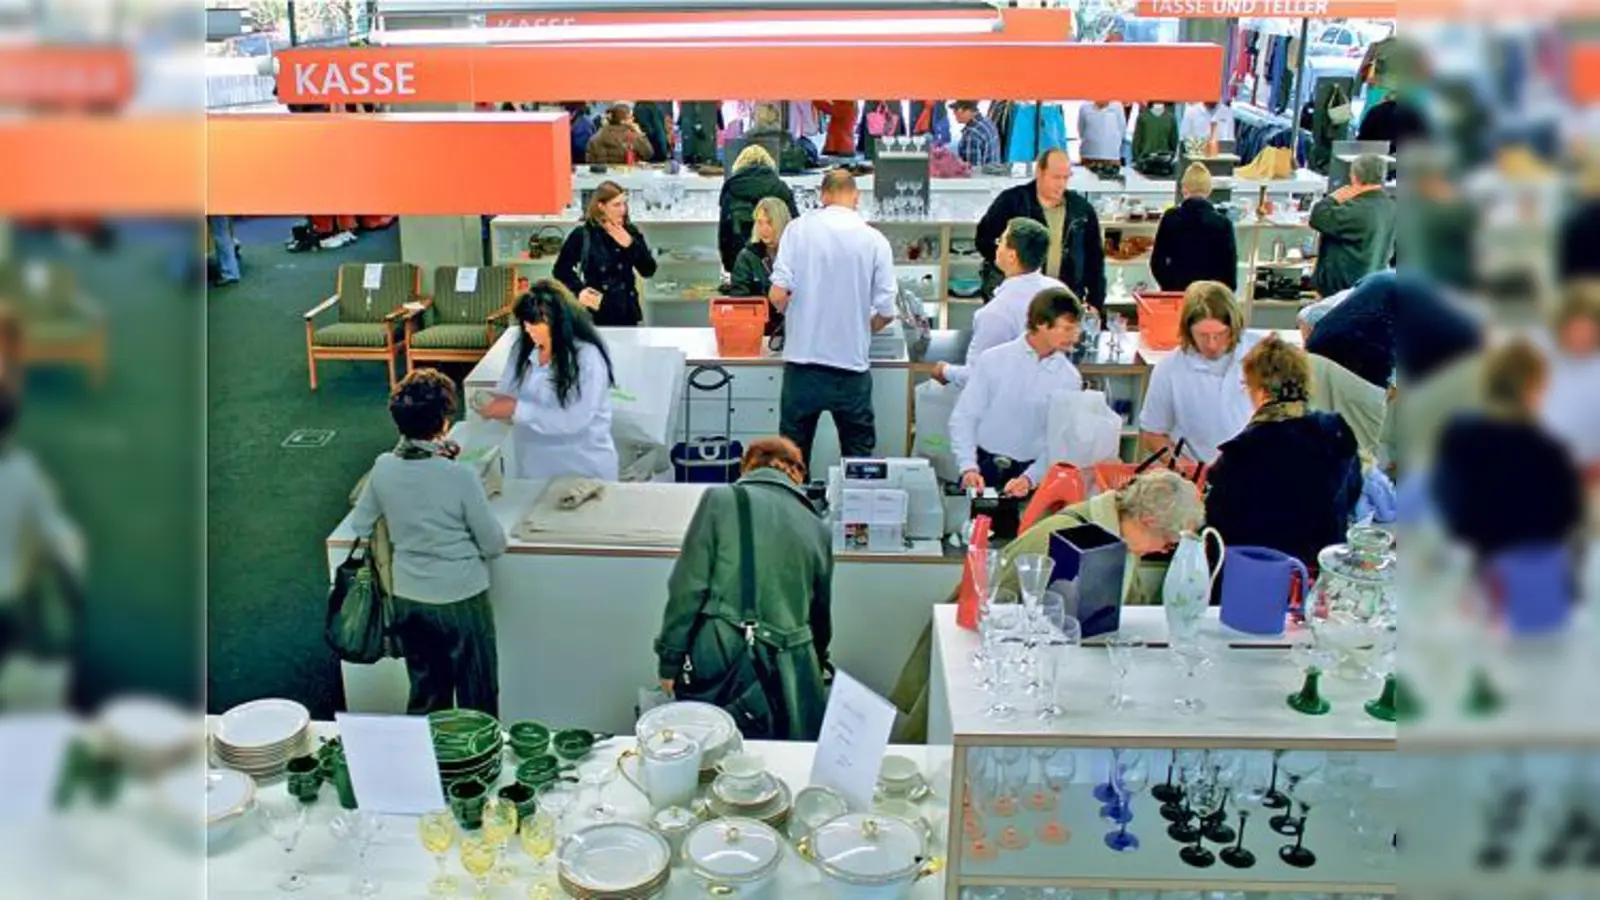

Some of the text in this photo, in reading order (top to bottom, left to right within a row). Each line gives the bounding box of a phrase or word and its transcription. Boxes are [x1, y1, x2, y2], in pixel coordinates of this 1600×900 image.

[1150, 0, 1327, 14] TASSE UND TELLER
[294, 61, 417, 96] KASSE
